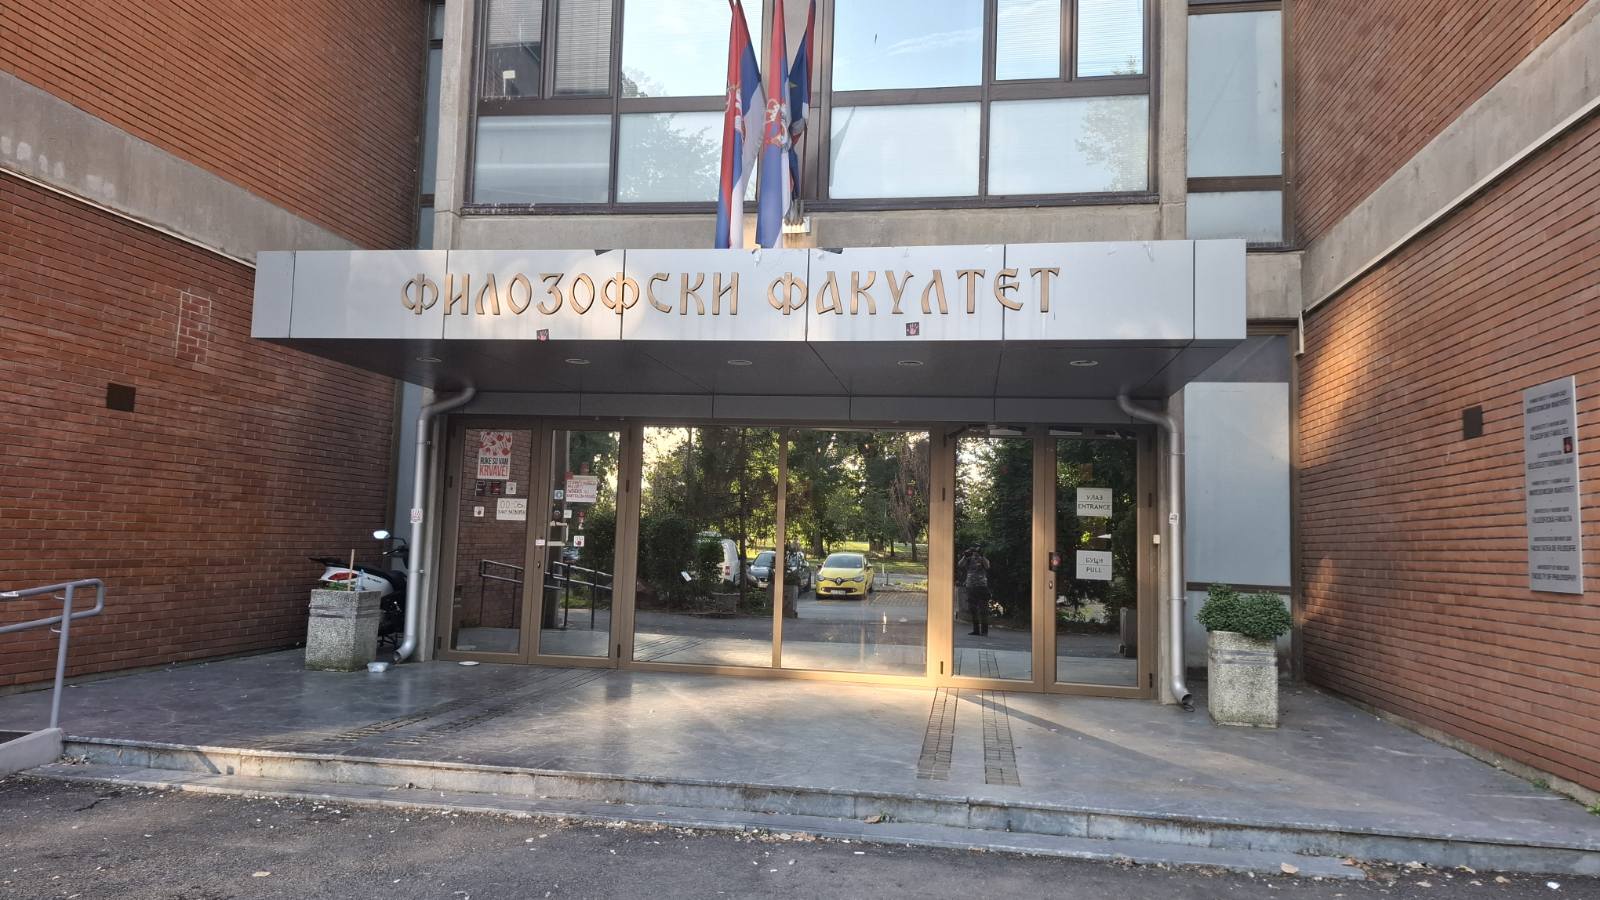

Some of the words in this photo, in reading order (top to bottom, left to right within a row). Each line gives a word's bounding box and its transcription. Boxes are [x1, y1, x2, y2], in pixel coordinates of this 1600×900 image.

[400, 270, 739, 316] ФИЛОЗОФСКИ
[766, 265, 1062, 316] ФАКУЛТЕТ
[1078, 503, 1111, 511] ENTRANCE
[1086, 566, 1103, 574] PULL
